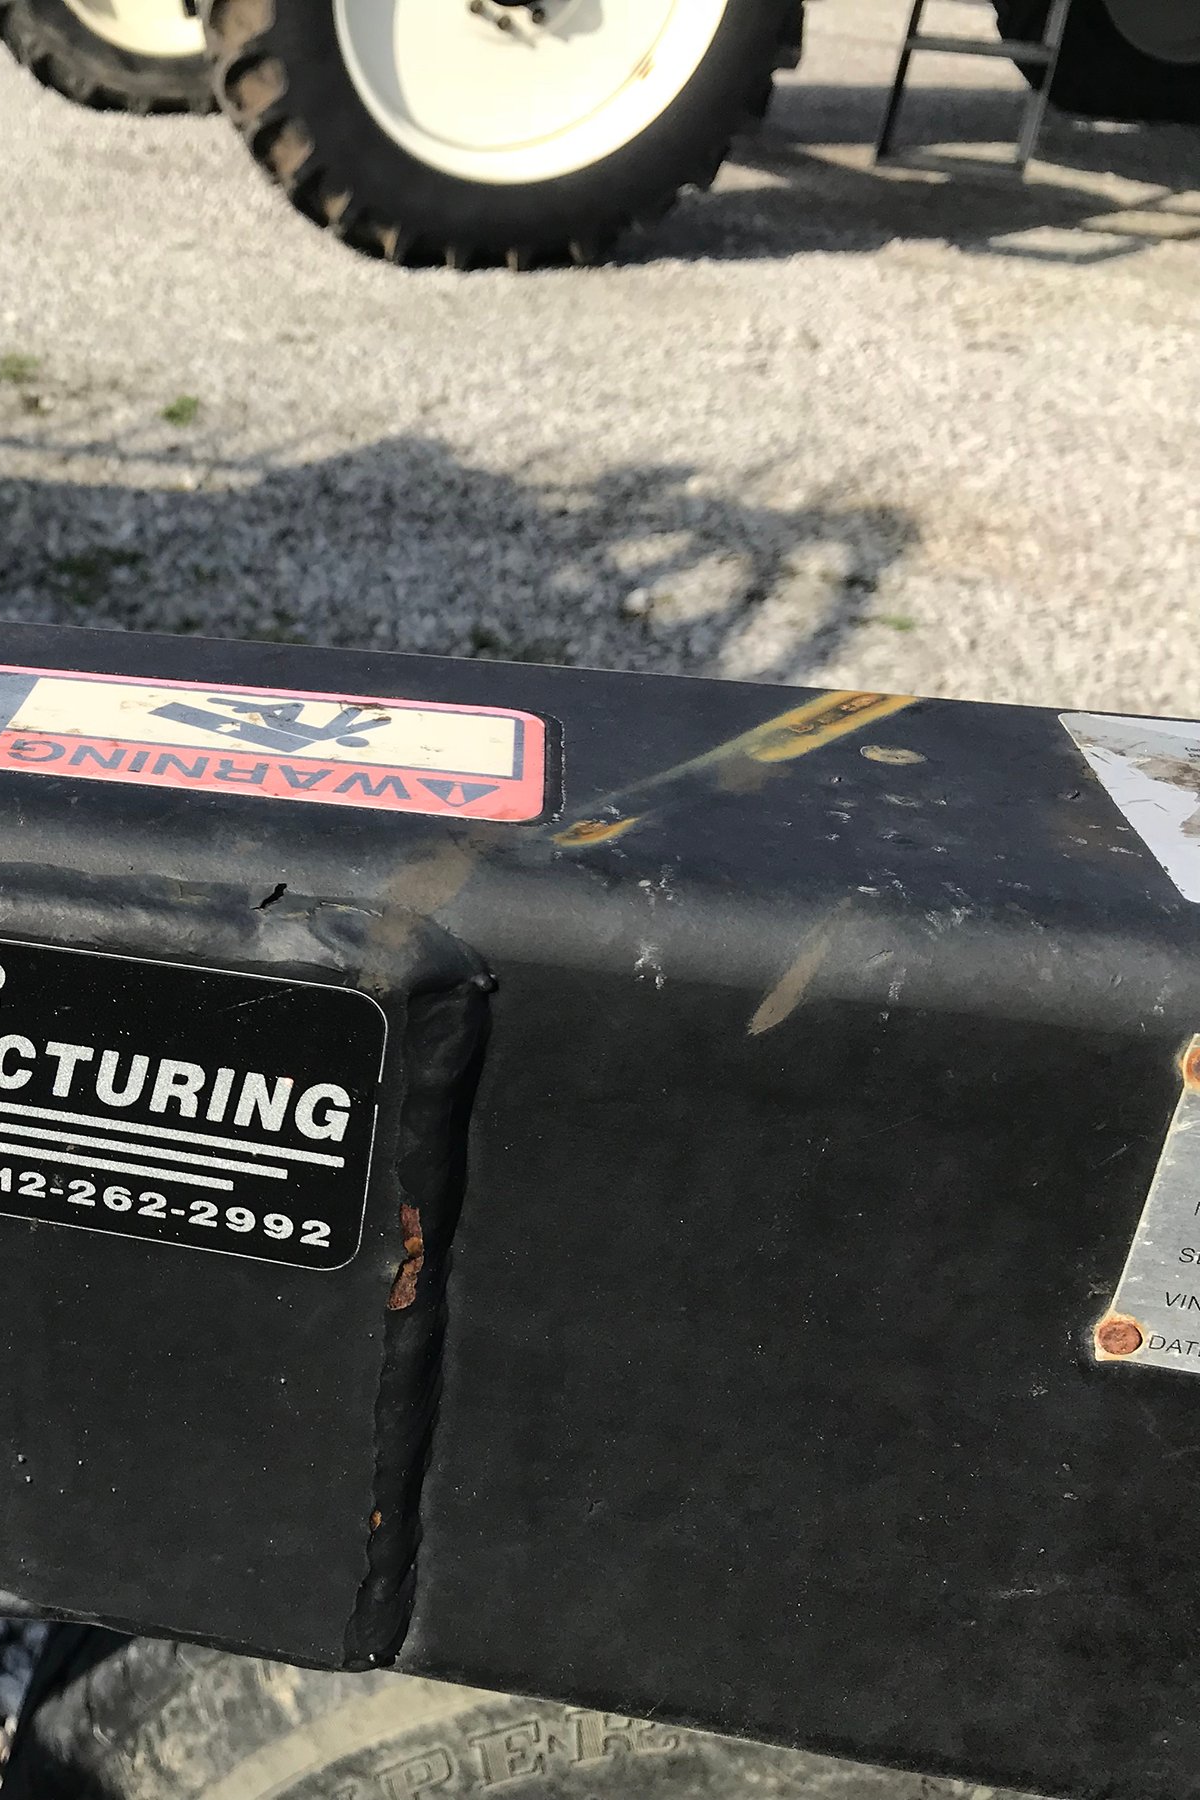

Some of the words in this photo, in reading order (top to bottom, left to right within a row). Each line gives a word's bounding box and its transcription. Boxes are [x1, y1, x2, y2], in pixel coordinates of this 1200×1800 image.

[4, 738, 413, 801] WARNING
[1179, 1247, 1200, 1265] S
[1148, 1334, 1200, 1358] DAT
